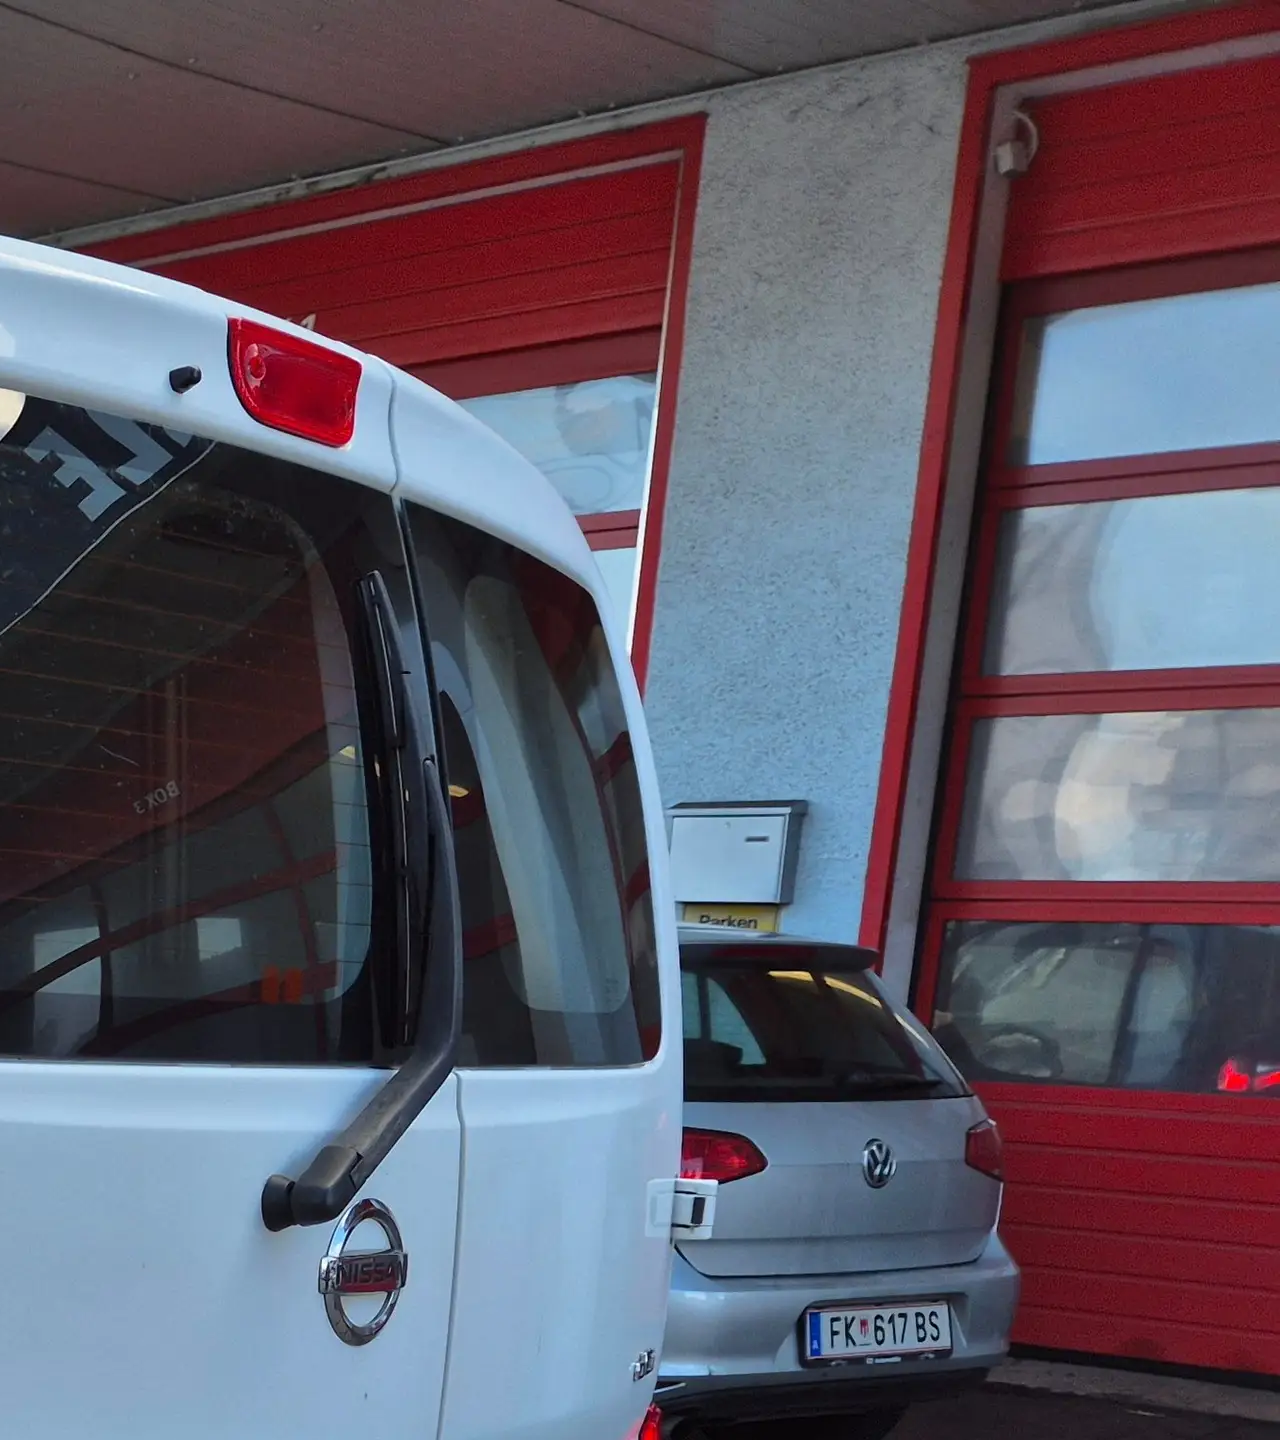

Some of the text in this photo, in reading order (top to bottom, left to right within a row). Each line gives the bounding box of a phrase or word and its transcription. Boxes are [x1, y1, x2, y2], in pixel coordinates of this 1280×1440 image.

[829, 1310, 940, 1349] FK 617 BS
